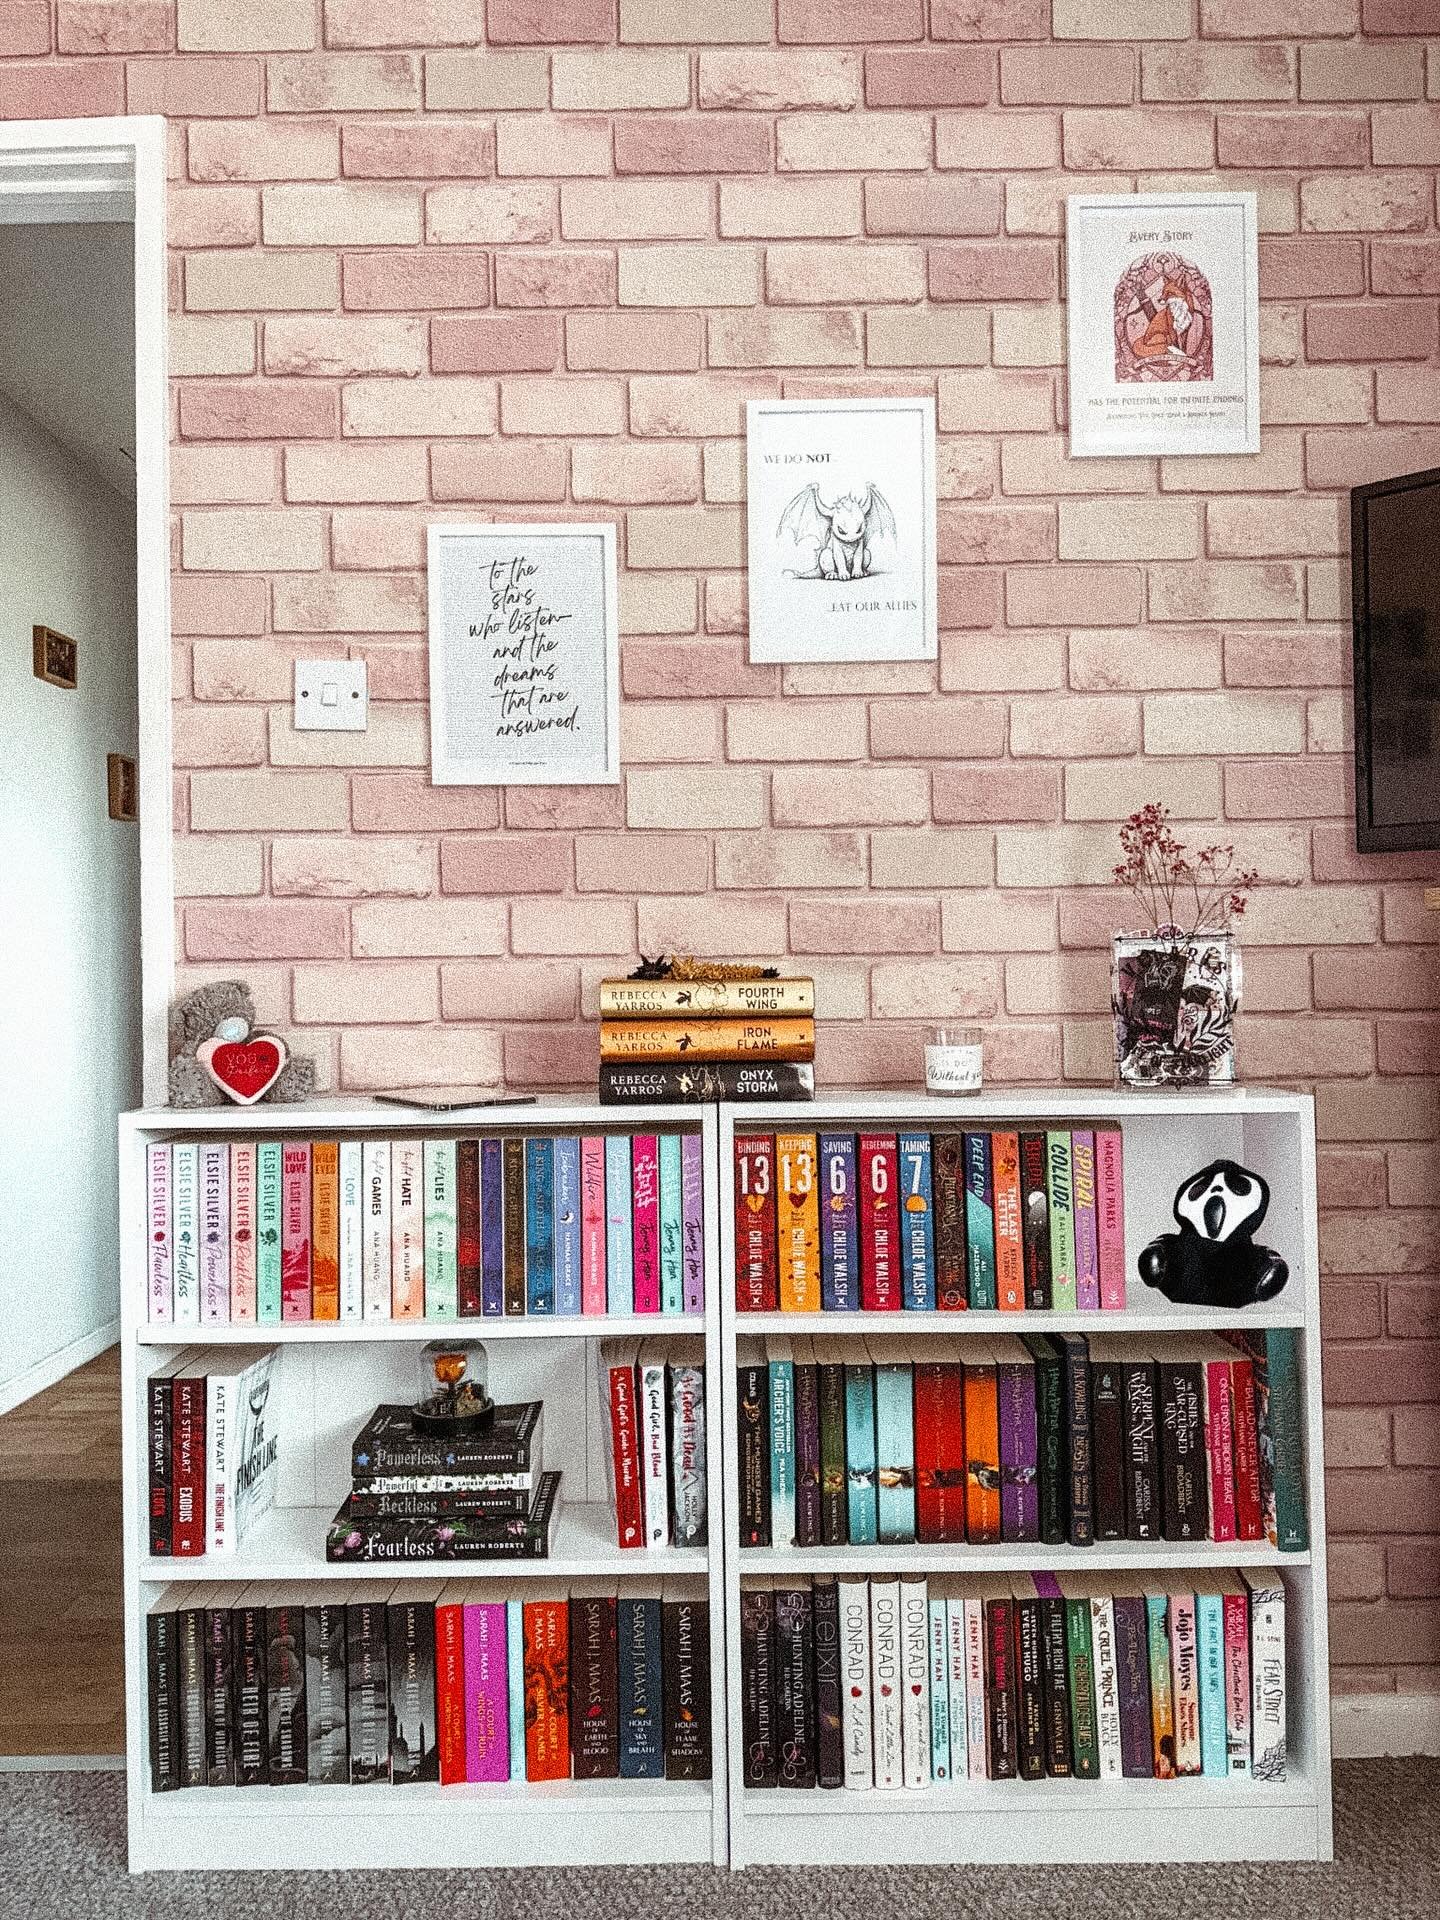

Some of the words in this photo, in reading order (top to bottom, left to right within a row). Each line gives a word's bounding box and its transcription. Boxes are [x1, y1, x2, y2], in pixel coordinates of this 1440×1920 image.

[763, 455, 781, 464] WE
[784, 455, 803, 464] DO
[806, 453, 832, 464] NOT
[479, 560, 503, 591] to
[502, 556, 539, 588] the
[491, 585, 536, 615] stars
[855, 601, 880, 611] OUR
[885, 600, 917, 611] ALLIES
[469, 614, 503, 641] who
[508, 606, 572, 637] listen
[493, 635, 526, 661] and
[522, 631, 559, 662] the
[494, 663, 560, 690] dreams
[491, 685, 545, 719] that
[539, 690, 570, 703] are
[496, 706, 581, 737] answered.
[611, 991, 667, 1000] REBECCA
[615, 1002, 663, 1011] YARROS
[738, 987, 784, 998] FOURTH
[746, 1000, 778, 1010] WING
[611, 1032, 668, 1041] REBECCA
[615, 1043, 663, 1051] YARROS
[737, 1039, 778, 1050] FLAME
[743, 1027, 771, 1038] IRON
[610, 1075, 667, 1085] REBECCA
[614, 1086, 663, 1095] YARROS
[736, 1081, 778, 1093] STORM
[740, 1070, 774, 1081] ONYX
[737, 1141, 771, 1153] BINDING
[823, 1141, 852, 1154] SAVING
[901, 1140, 931, 1152] TAMING
[972, 1138, 985, 1172] DEEP
[154, 1151, 164, 1183] ELSIE
[179, 1152, 191, 1184] ELSIE
[207, 1153, 220, 1184] ELSIE
[237, 1152, 250, 1183] ELSIE
[264, 1151, 275, 1180] ELSIE
[739, 1155, 770, 1195] 13
[781, 1153, 812, 1193] 13
[830, 1155, 846, 1196] 6
[871, 1154, 888, 1194] 6
[908, 1156, 922, 1194] 7
[1052, 1144, 1070, 1213] COLLIDE
[1075, 1144, 1094, 1210] SPIRAL
[1104, 1140, 1114, 1192] MAGNOLIA
[264, 1184, 275, 1221] SILVER
[372, 1177, 382, 1216] GAMES
[402, 1178, 412, 1206] HATE
[435, 1177, 444, 1201] LIES
[1007, 1187, 1018, 1211] THE
[154, 1186, 164, 1227] SILVER
[179, 1189, 191, 1227] SILVER
[207, 1189, 220, 1228] SILVER
[237, 1188, 250, 1226] SILVER
[998, 1192, 1008, 1236] LETTER
[1106, 1197, 1116, 1229] PARKS
[792, 1228, 806, 1258] CHLOE
[876, 1230, 888, 1258] CHLOE
[1008, 1213, 1019, 1244] LAST
[750, 1230, 762, 1260] CHLOE
[833, 1230, 846, 1260] CHLOE
[912, 1230, 926, 1260] CHLOE
[154, 1244, 168, 1297] Flawless
[178, 1245, 195, 1298] Heartless
[750, 1262, 762, 1295] WALSH
[792, 1260, 806, 1292] WALSH
[833, 1262, 846, 1295] WALSH
[876, 1261, 888, 1294] WALSH
[912, 1262, 926, 1295] WALSH
[154, 1386, 164, 1415] KATE
[182, 1386, 191, 1415] KATE
[216, 1385, 225, 1414] KATE
[650, 1390, 660, 1410] Good
[773, 1378, 785, 1425] ARCHER'S
[1245, 1387, 1256, 1425] BALLAD
[154, 1419, 164, 1474] STEWART
[182, 1419, 191, 1474] STEWART
[216, 1418, 225, 1473] STEWART
[774, 1426, 786, 1454] VOICE
[1248, 1431, 1257, 1466] NEVER
[652, 1452, 661, 1478] Blood
[215, 1483, 225, 1494] THE
[1134, 1470, 1144, 1520] BROADBENT
[1176, 1464, 1185, 1514] BROADBENT
[1184, 1472, 1193, 1506] CARISSA
[179, 1487, 192, 1523] EXODUS
[215, 1496, 225, 1517] FINISH
[215, 1518, 225, 1532] LINE
[320, 1610, 328, 1640] SARAH
[362, 1608, 371, 1638] SARAH
[480, 1610, 488, 1642] SARAH
[535, 1618, 544, 1650] MAAS
[548, 1610, 556, 1647] SARAH
[587, 1603, 600, 1650] SARAH
[633, 1604, 645, 1648] SARAH
[679, 1606, 692, 1650] SARAH
[877, 1598, 894, 1680] CONRAD
[908, 1598, 926, 1679] CONRAD
[934, 1616, 942, 1652] JENNY
[952, 1616, 960, 1652] JENNY
[970, 1614, 978, 1650] JENNY
[1022, 1610, 1030, 1648] EVELYN
[1051, 1614, 1062, 1645] FILTHY
[1176, 1608, 1193, 1642] Jojo
[816, 1620, 837, 1688] elixir
[846, 1604, 864, 1680] CONRAD
[1100, 1630, 1111, 1666] CRUEL
[188, 1658, 197, 1684] MAAS
[322, 1654, 330, 1682] MAAS
[363, 1654, 372, 1680] MAAS
[408, 1652, 416, 1680] MAAS
[480, 1652, 489, 1681] MAAS
[757, 1632, 768, 1694] HAUNTING
[792, 1635, 803, 1689] HUNTING
[934, 1658, 944, 1682] HAN
[1023, 1651, 1032, 1682] HUGO
[1052, 1648, 1064, 1671] RICH
[1178, 1646, 1194, 1692] Moyes
[1263, 1658, 1281, 1685] FEAR
[589, 1662, 602, 1704] MAAS
[634, 1663, 646, 1703] MAAS
[680, 1665, 693, 1706] MAAS
[1054, 1674, 1065, 1691] FAE
[1102, 1666, 1114, 1708] PRINCE
[242, 1686, 260, 1715] HEIR
[550, 1716, 558, 1750] COURT
[794, 1692, 804, 1744] ADELINE
[1101, 1713, 1110, 1747] BLACK
[1110, 1713, 1118, 1746] HOLLY
[242, 1742, 260, 1769] FIRE
[1056, 1740, 1064, 1754] LEE
